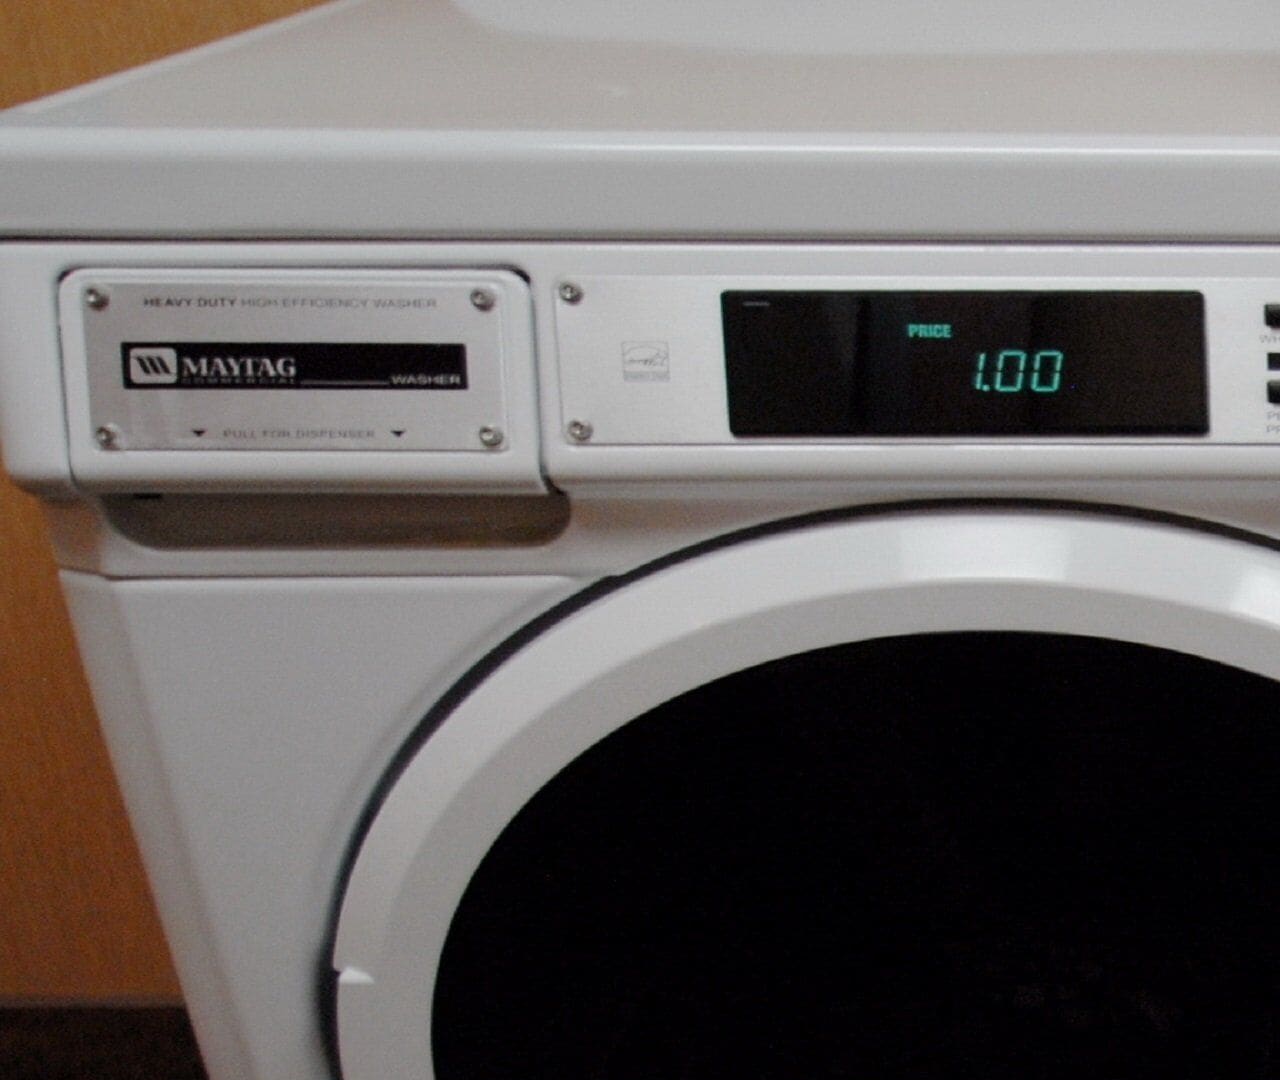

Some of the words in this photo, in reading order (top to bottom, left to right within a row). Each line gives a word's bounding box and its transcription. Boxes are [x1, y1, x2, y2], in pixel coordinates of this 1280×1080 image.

[143, 298, 192, 308] HEAVY
[197, 298, 237, 308] DUTY
[374, 299, 437, 310] WASHER
[908, 323, 953, 339] PRICE
[182, 356, 297, 377] MAYTAG
[974, 349, 1064, 393] 1.00
[391, 374, 461, 385] WASHER
